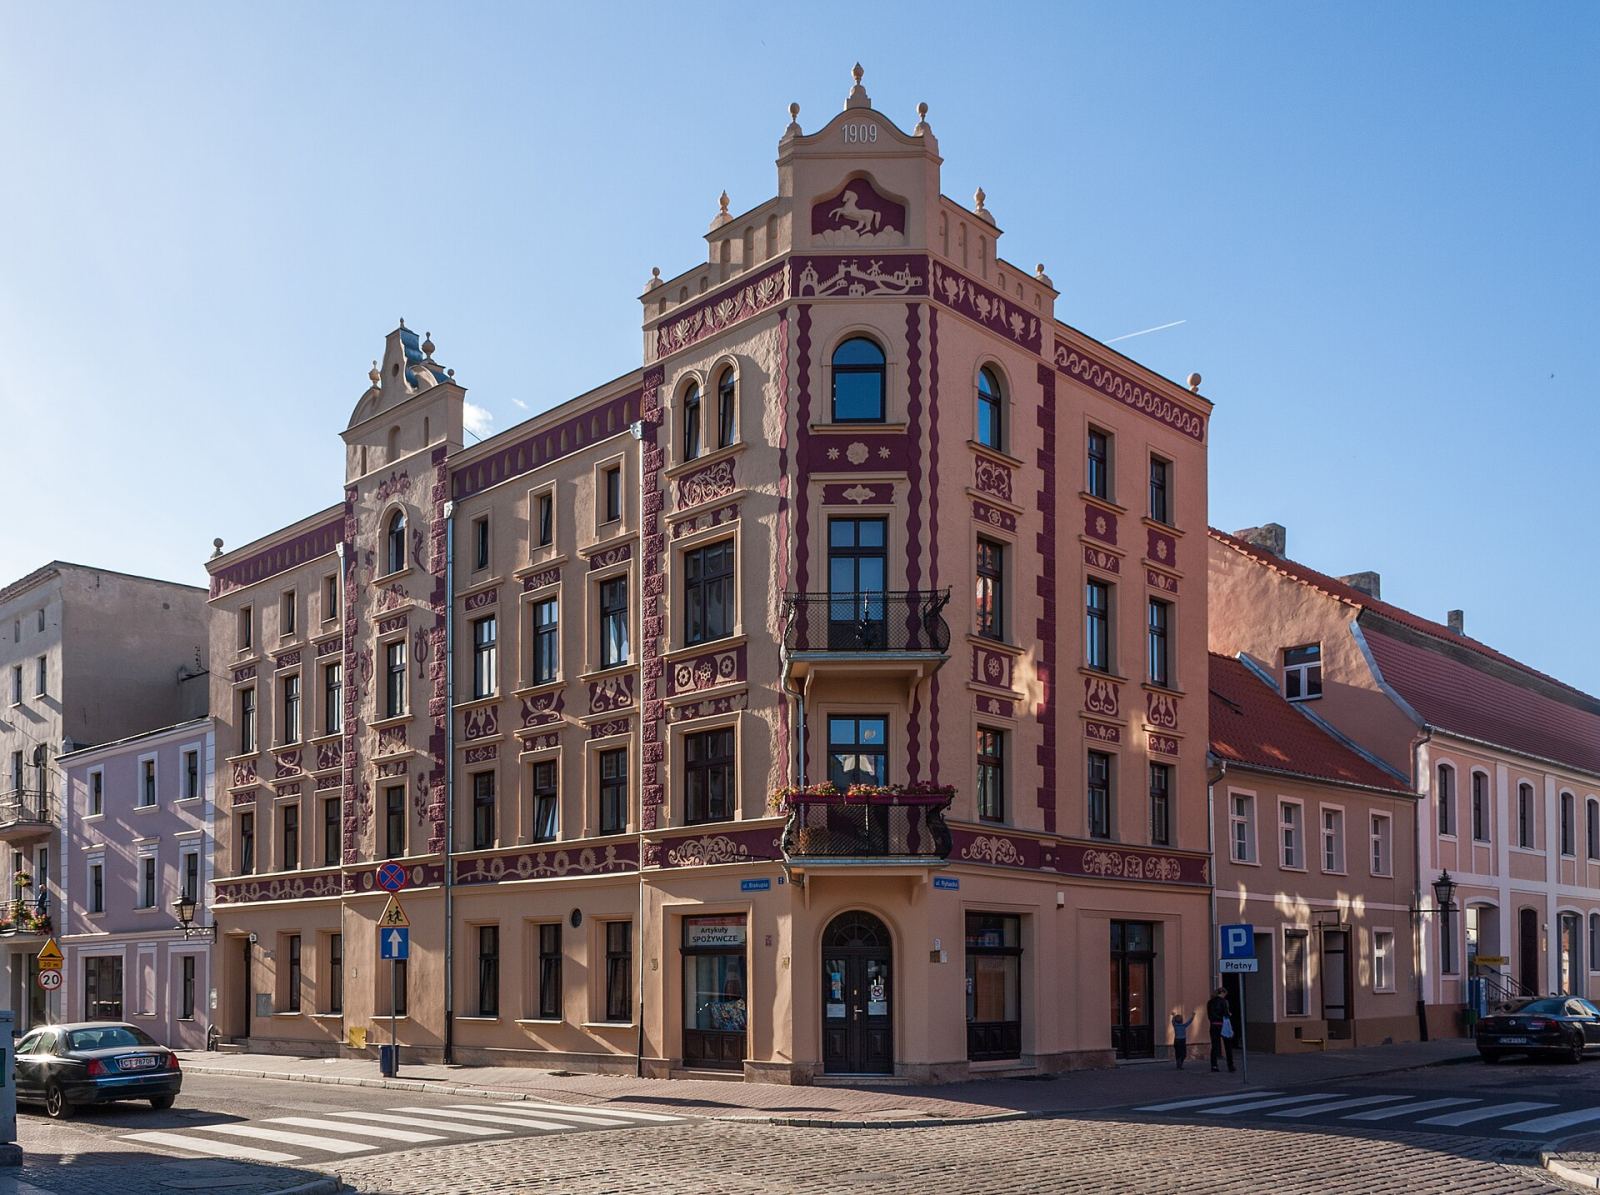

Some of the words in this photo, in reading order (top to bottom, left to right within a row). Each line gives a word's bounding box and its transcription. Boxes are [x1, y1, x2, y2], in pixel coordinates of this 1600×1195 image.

[842, 124, 877, 143] 1909
[700, 927, 729, 935] Artykuły
[692, 935, 738, 943] SPOŻYWCZE
[1228, 928, 1247, 954] P
[1225, 961, 1252, 971] Płatny
[43, 974, 60, 986] 20
